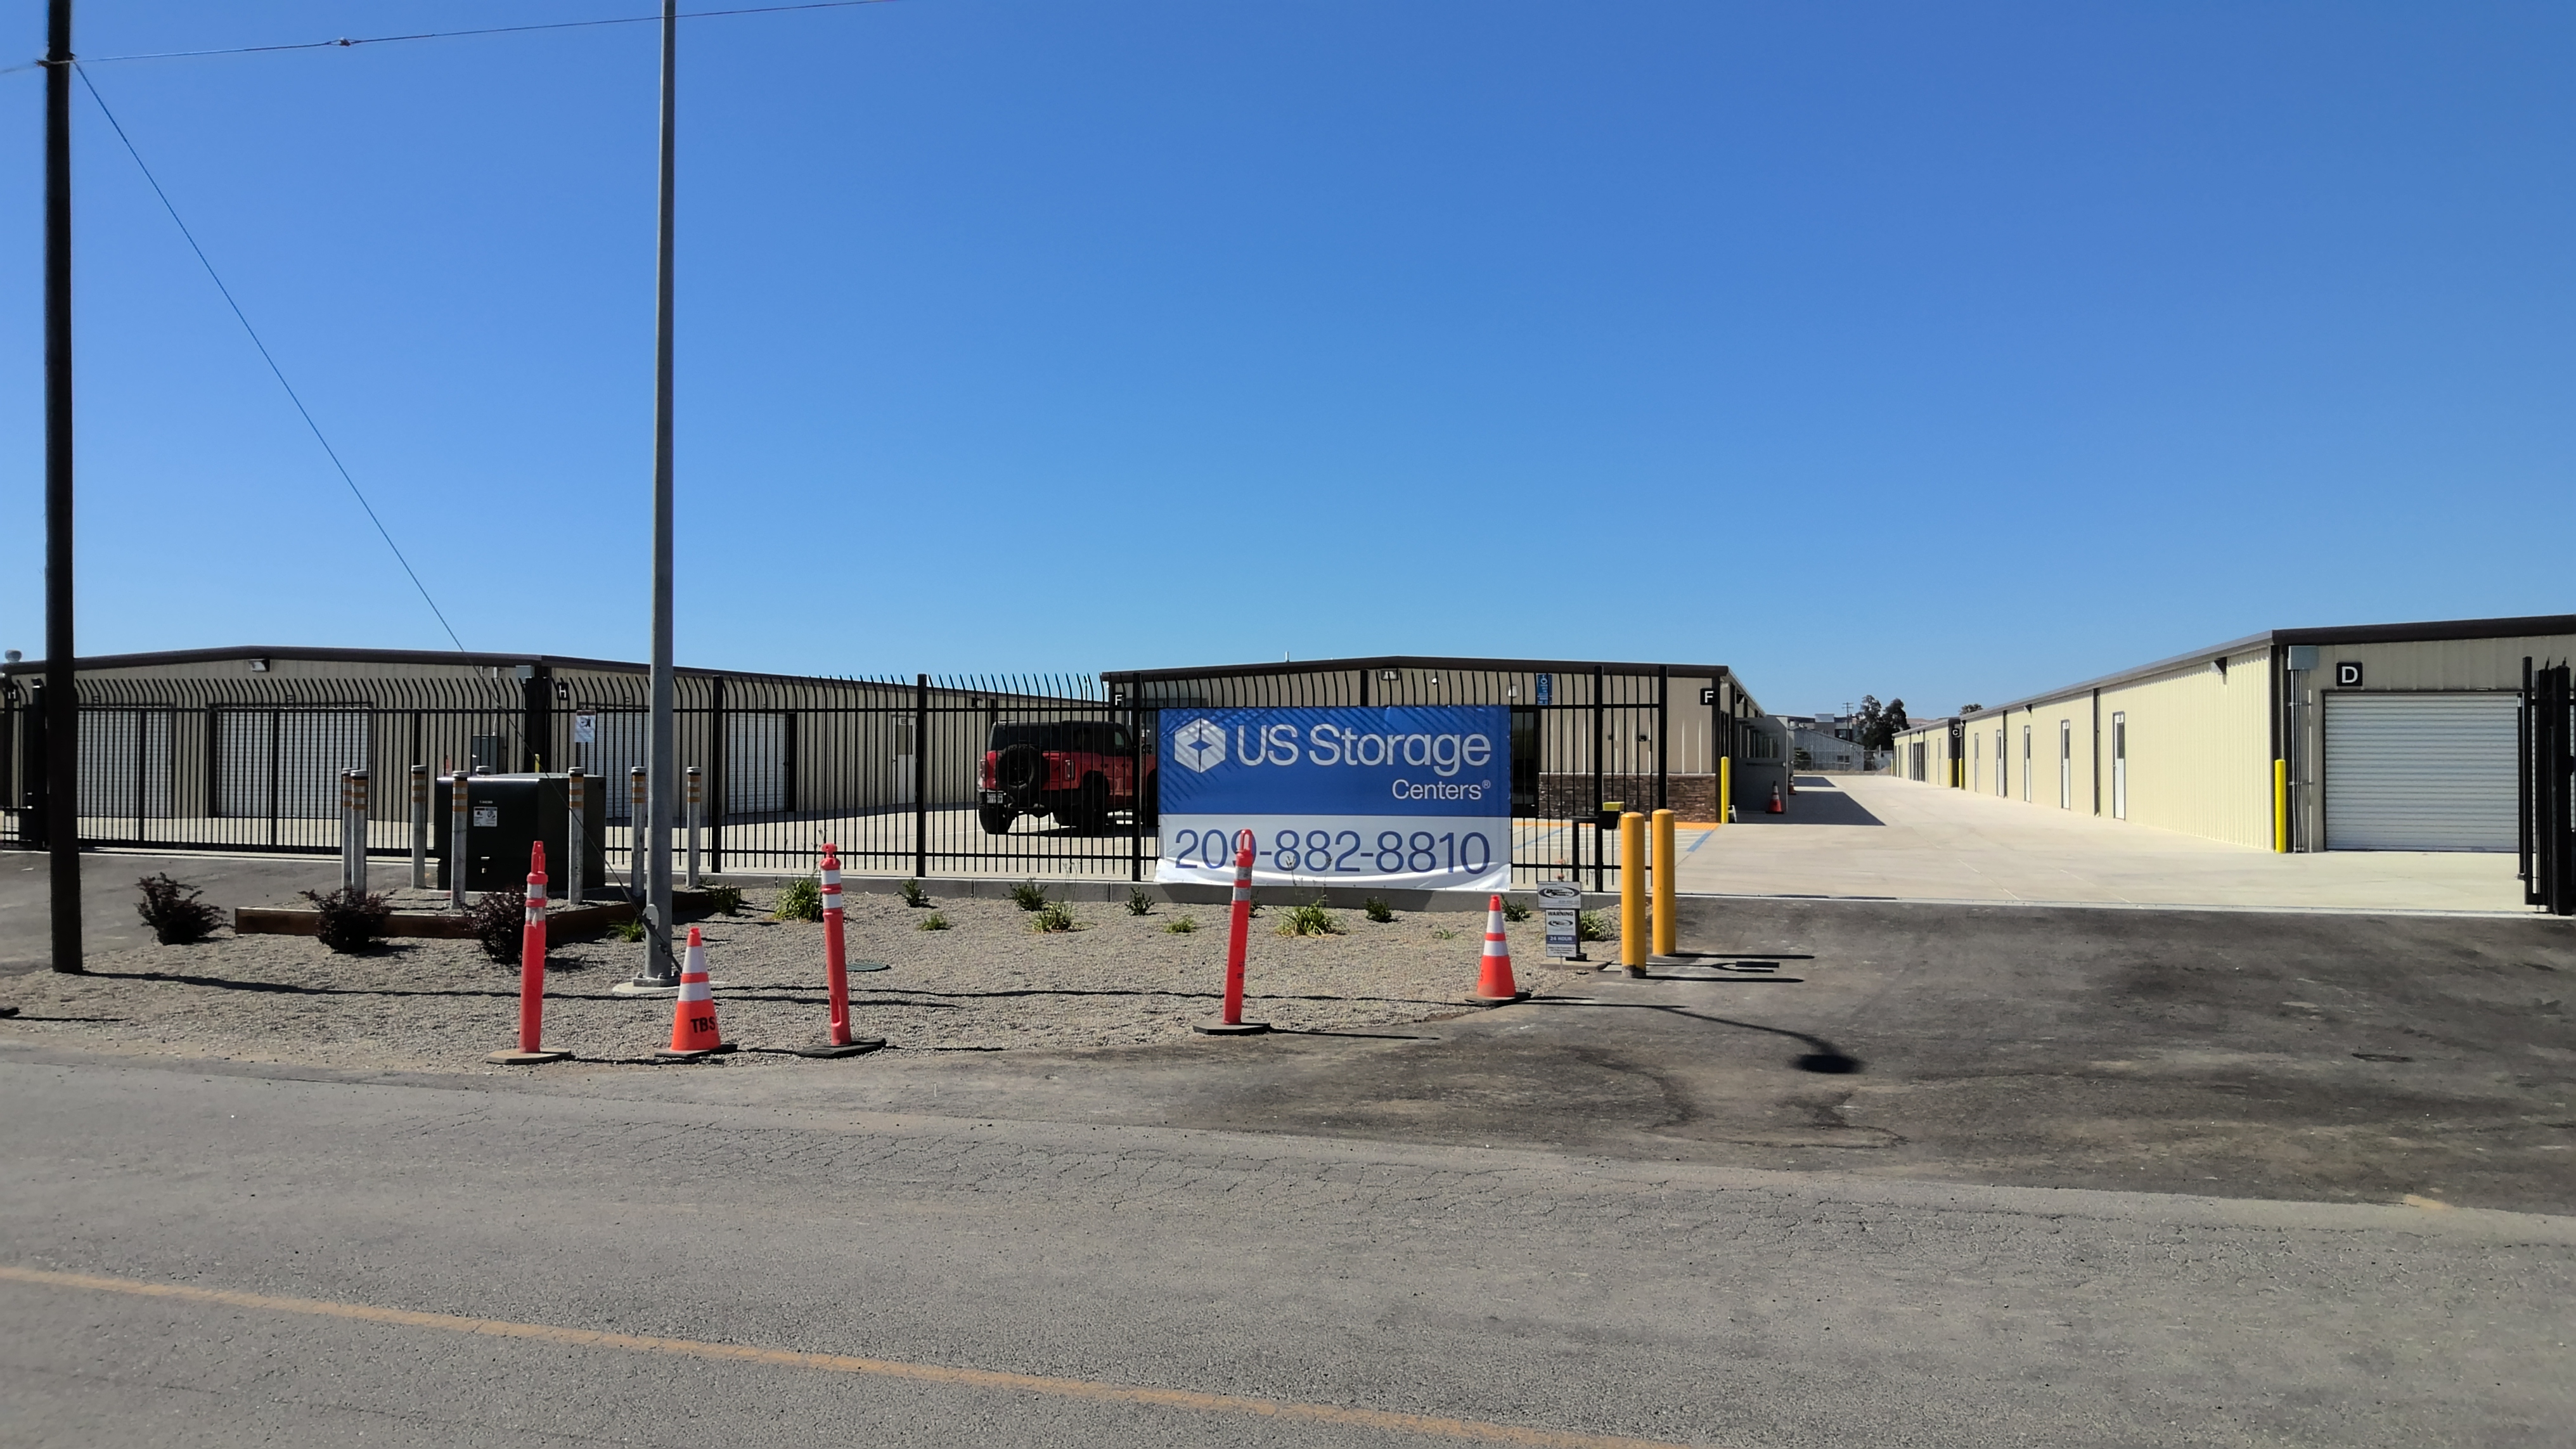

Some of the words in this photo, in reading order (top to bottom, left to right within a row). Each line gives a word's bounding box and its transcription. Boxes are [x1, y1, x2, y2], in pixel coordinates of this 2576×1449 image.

[2341, 666, 2358, 683] D
[558, 685, 567, 698] H
[1704, 690, 1714, 703] F
[1115, 694, 1123, 706] F
[1237, 724, 1299, 766] US
[1308, 723, 1491, 776] Storage
[690, 1016, 716, 1033] TBS
